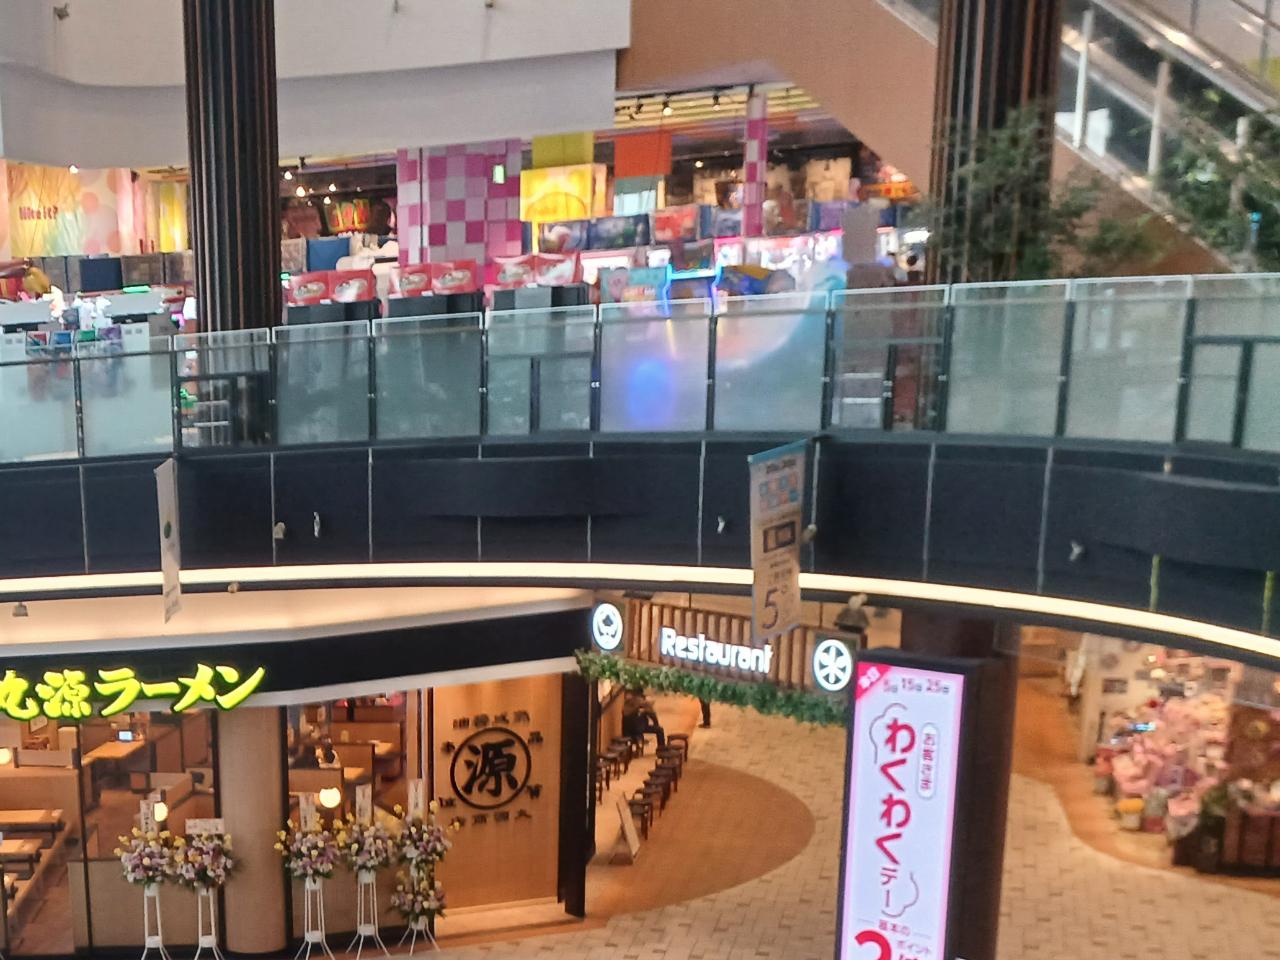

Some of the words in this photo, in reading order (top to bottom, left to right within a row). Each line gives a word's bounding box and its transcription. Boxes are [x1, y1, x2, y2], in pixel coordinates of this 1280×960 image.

[660, 626, 773, 674] Restaurant
[461, 737, 519, 798] 源
[874, 717, 917, 908] わくわくデー
